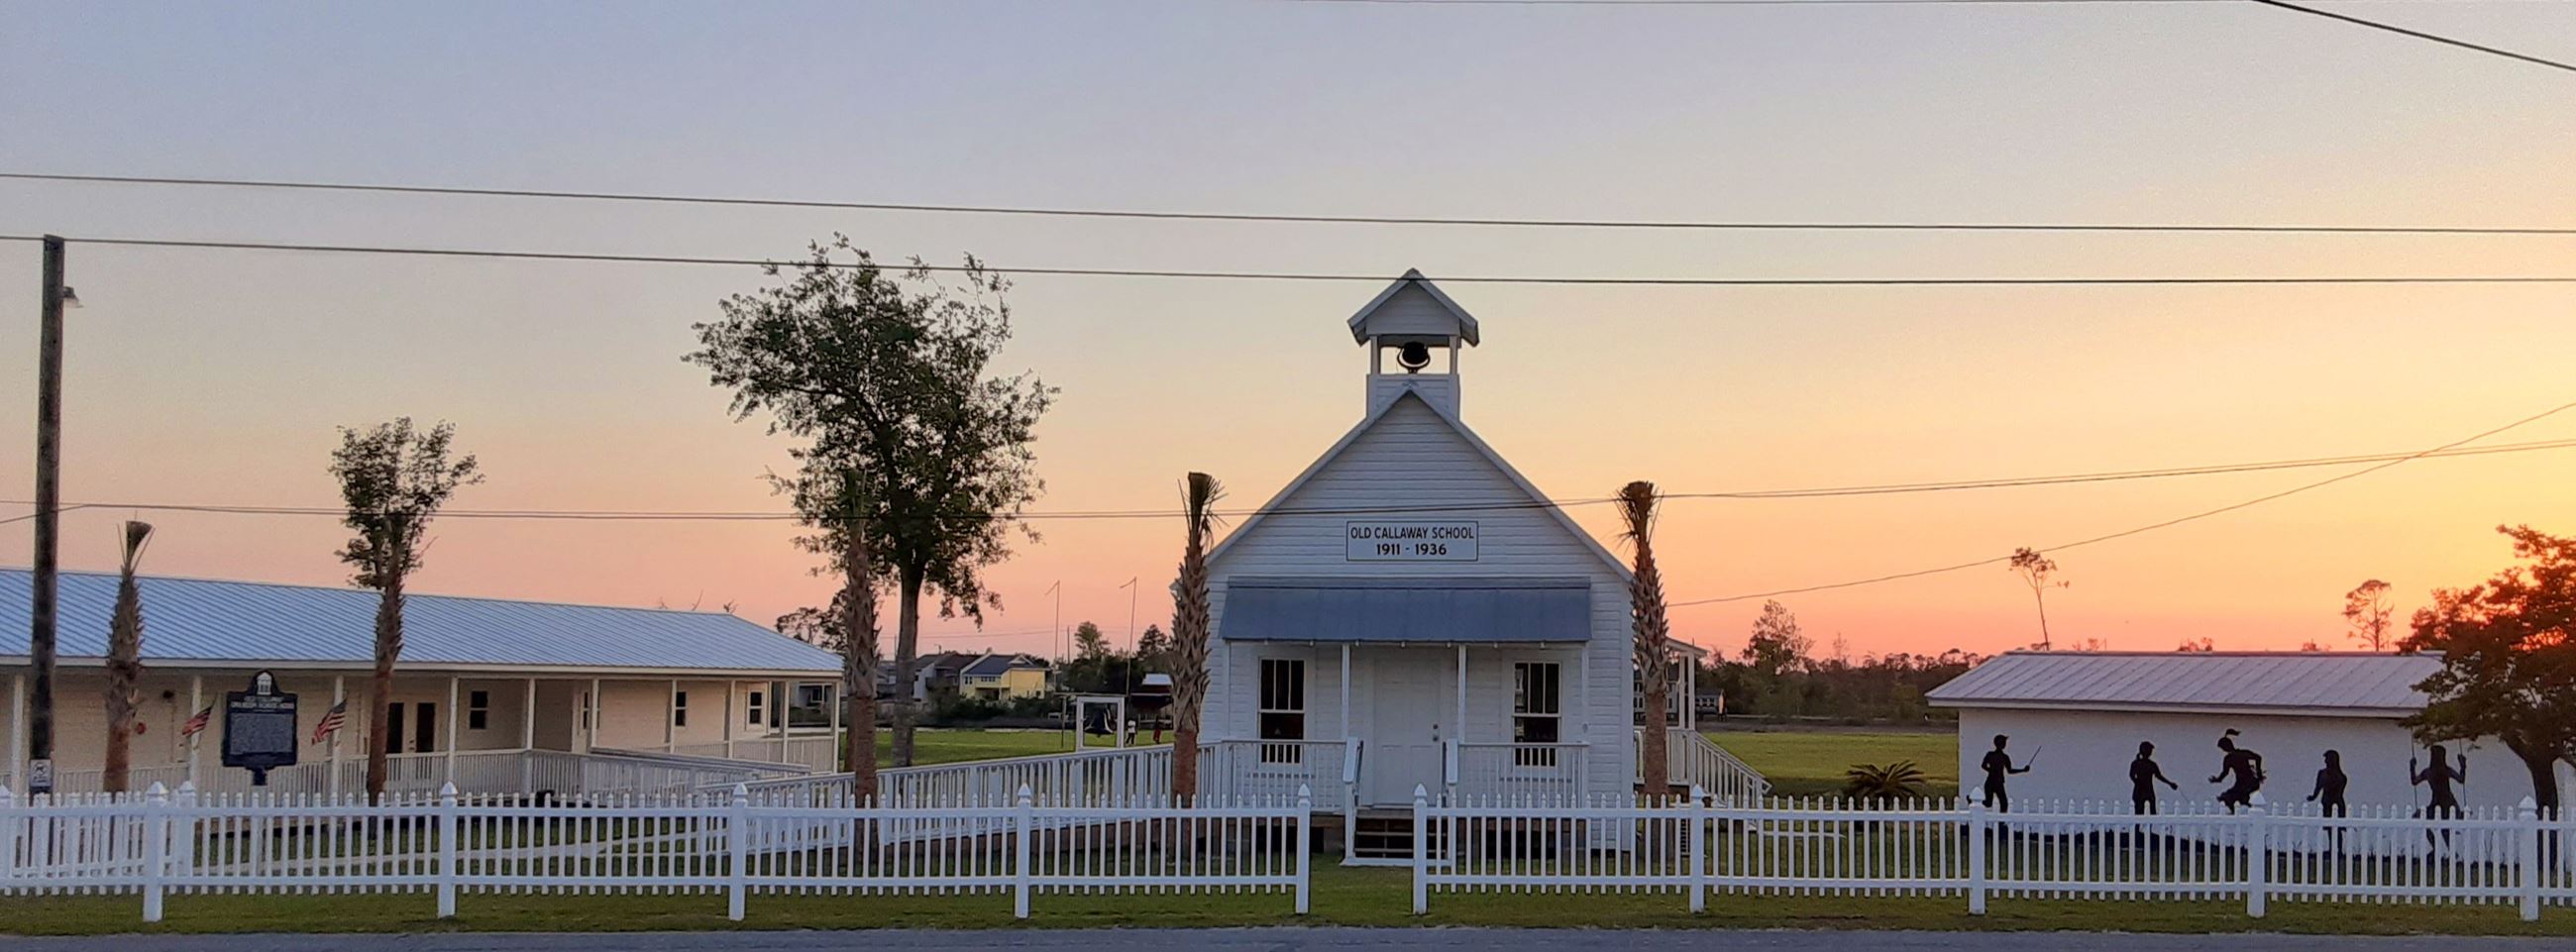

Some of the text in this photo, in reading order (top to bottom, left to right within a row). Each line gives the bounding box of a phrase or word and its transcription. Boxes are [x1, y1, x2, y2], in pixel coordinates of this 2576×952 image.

[1350, 527, 1474, 539] OLD CALLAWAY SCHOOL
[1376, 543, 1401, 555] 1911
[1415, 543, 1448, 555] 1936
